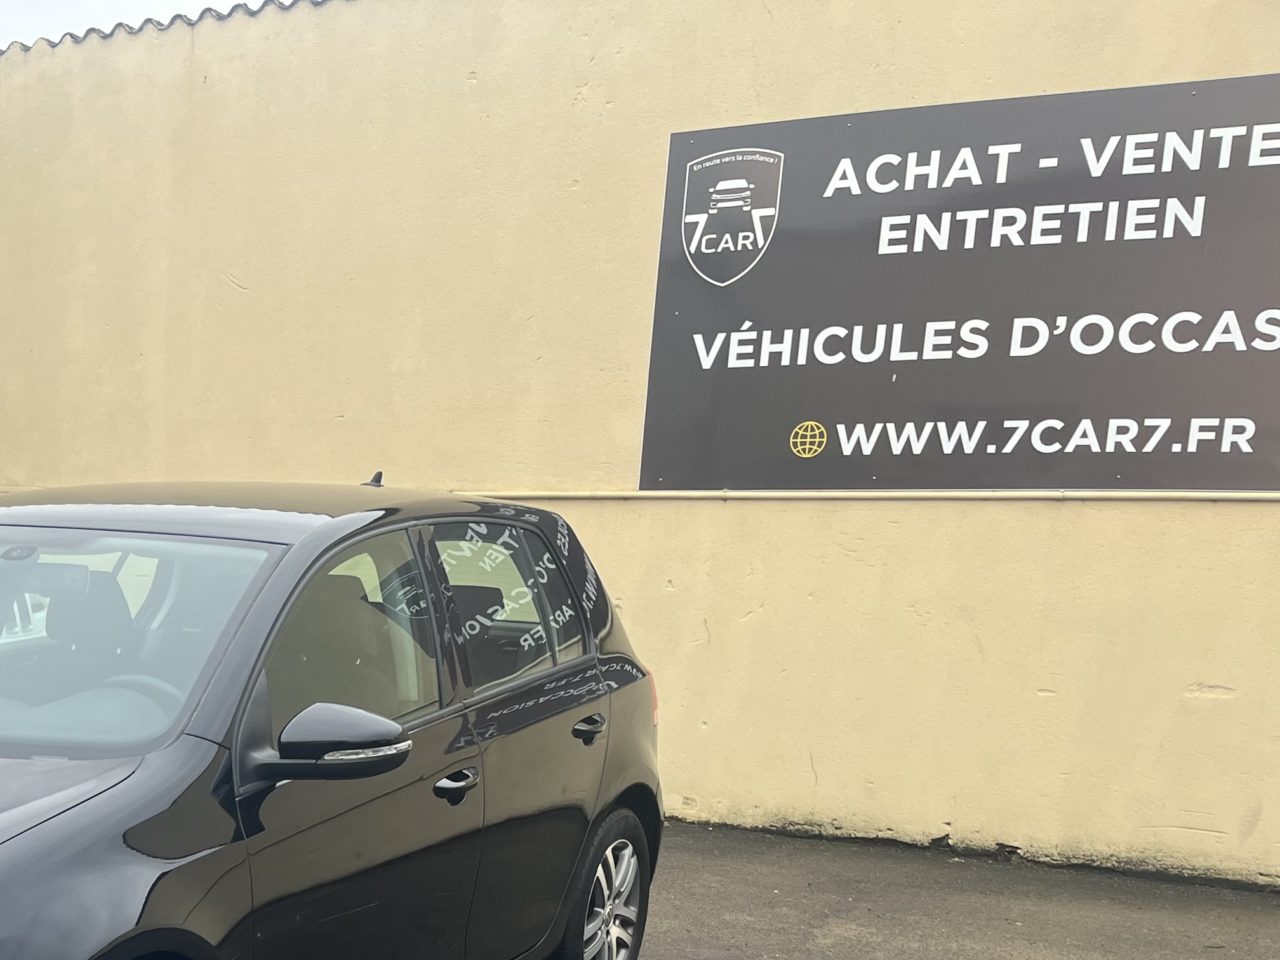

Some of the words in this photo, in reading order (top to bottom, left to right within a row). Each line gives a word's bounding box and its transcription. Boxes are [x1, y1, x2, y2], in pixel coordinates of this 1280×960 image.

[704, 159, 720, 168] route
[743, 153, 775, 164] confiance
[823, 143, 1022, 198] ACHAT
[1038, 157, 1059, 169] -
[1079, 122, 1280, 178] VENTE
[878, 195, 1207, 255] ENTRETIEN
[692, 320, 991, 370] VÉHICULES
[836, 417, 1257, 456] WWW.7CAR7.FR
